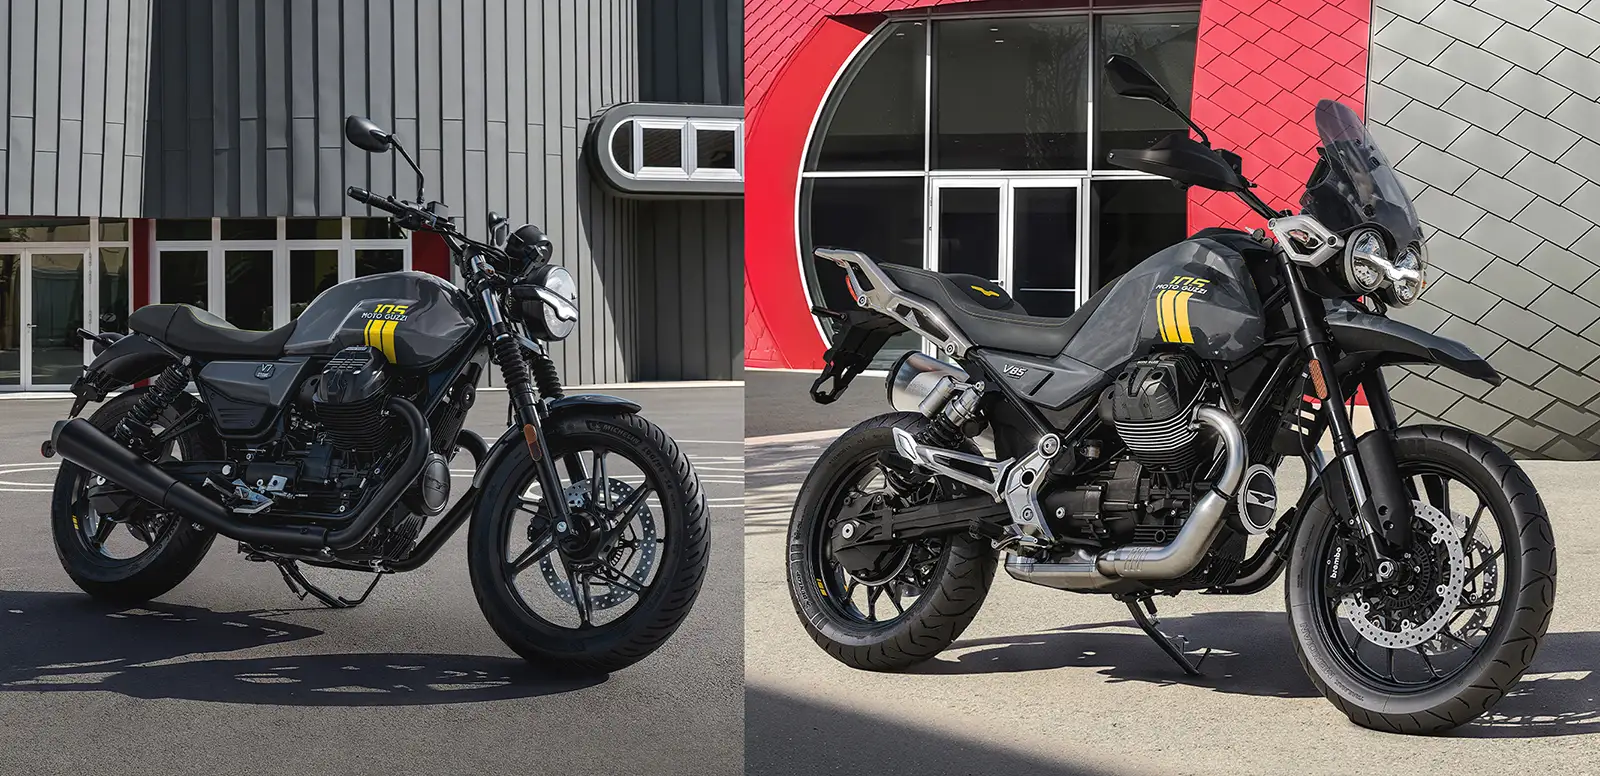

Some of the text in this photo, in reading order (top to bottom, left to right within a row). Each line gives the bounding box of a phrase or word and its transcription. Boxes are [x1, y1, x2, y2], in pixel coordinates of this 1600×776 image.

[1181, 286, 1207, 294] GUZZI
[384, 313, 408, 322] GUZZI
[261, 363, 274, 372] V7
[1003, 364, 1027, 376] V85
[602, 424, 640, 444] MICHELIN
[1329, 546, 1342, 579] brembo
[795, 570, 808, 600] DUNLOP
[1300, 622, 1335, 681] MERIDIAN
